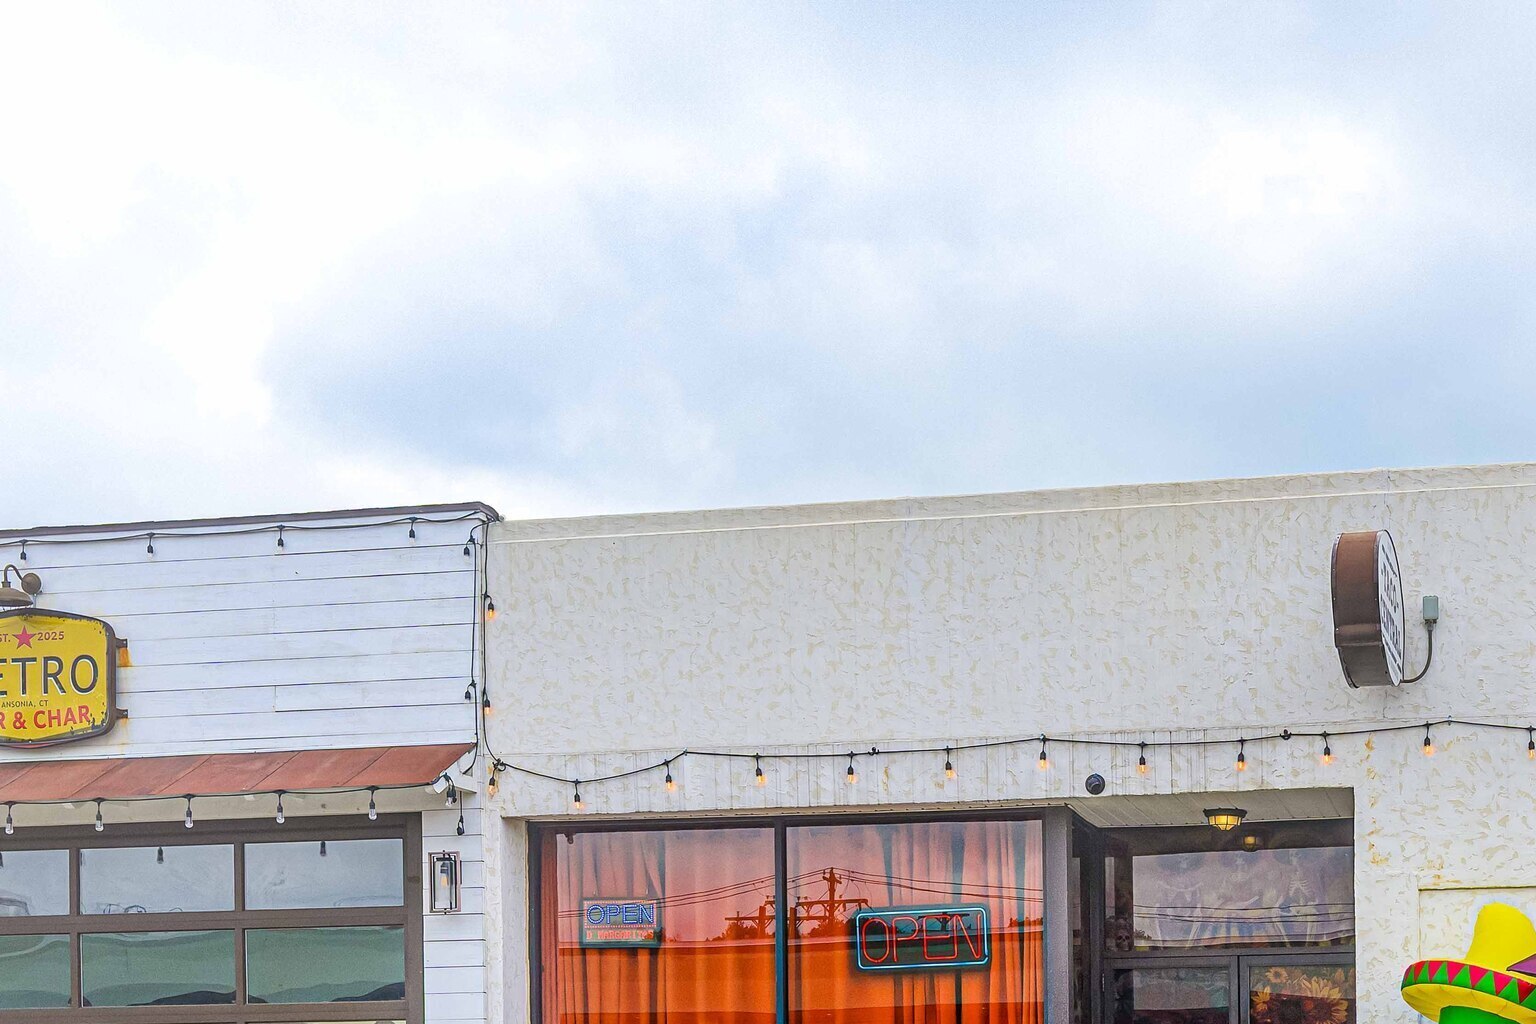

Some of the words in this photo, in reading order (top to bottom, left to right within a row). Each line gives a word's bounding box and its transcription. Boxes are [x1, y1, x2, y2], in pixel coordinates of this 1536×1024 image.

[0, 633, 11, 642] T.
[37, 631, 65, 641] 2025
[1, 700, 36, 708] ANSONIA,
[39, 699, 49, 707] CT
[12, 711, 27, 730] &
[33, 704, 91, 729] CHAR
[586, 903, 655, 924] OPEN
[861, 913, 982, 964] OPEN
